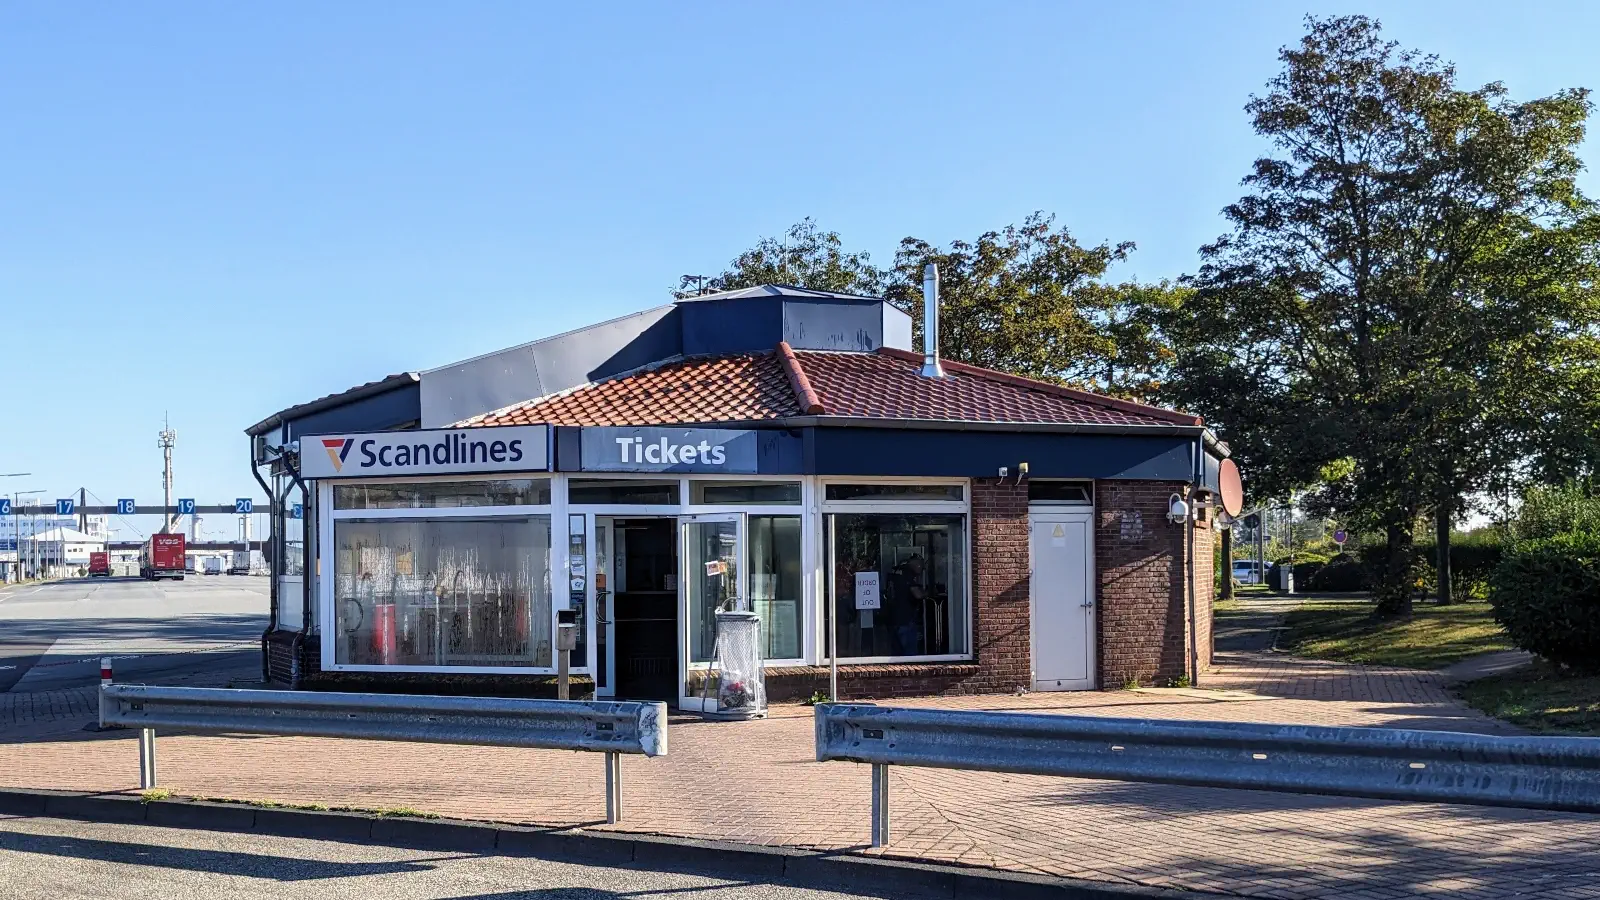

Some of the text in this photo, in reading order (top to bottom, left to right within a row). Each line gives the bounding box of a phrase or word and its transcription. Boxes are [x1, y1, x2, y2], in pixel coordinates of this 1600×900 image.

[360, 433, 523, 467] Scandlines
[616, 437, 725, 465] Tickets
[0, 500, 10, 513] 6
[57, 500, 73, 513] 17
[118, 500, 134, 513] 18
[179, 500, 194, 513] 19
[236, 500, 252, 512] 20
